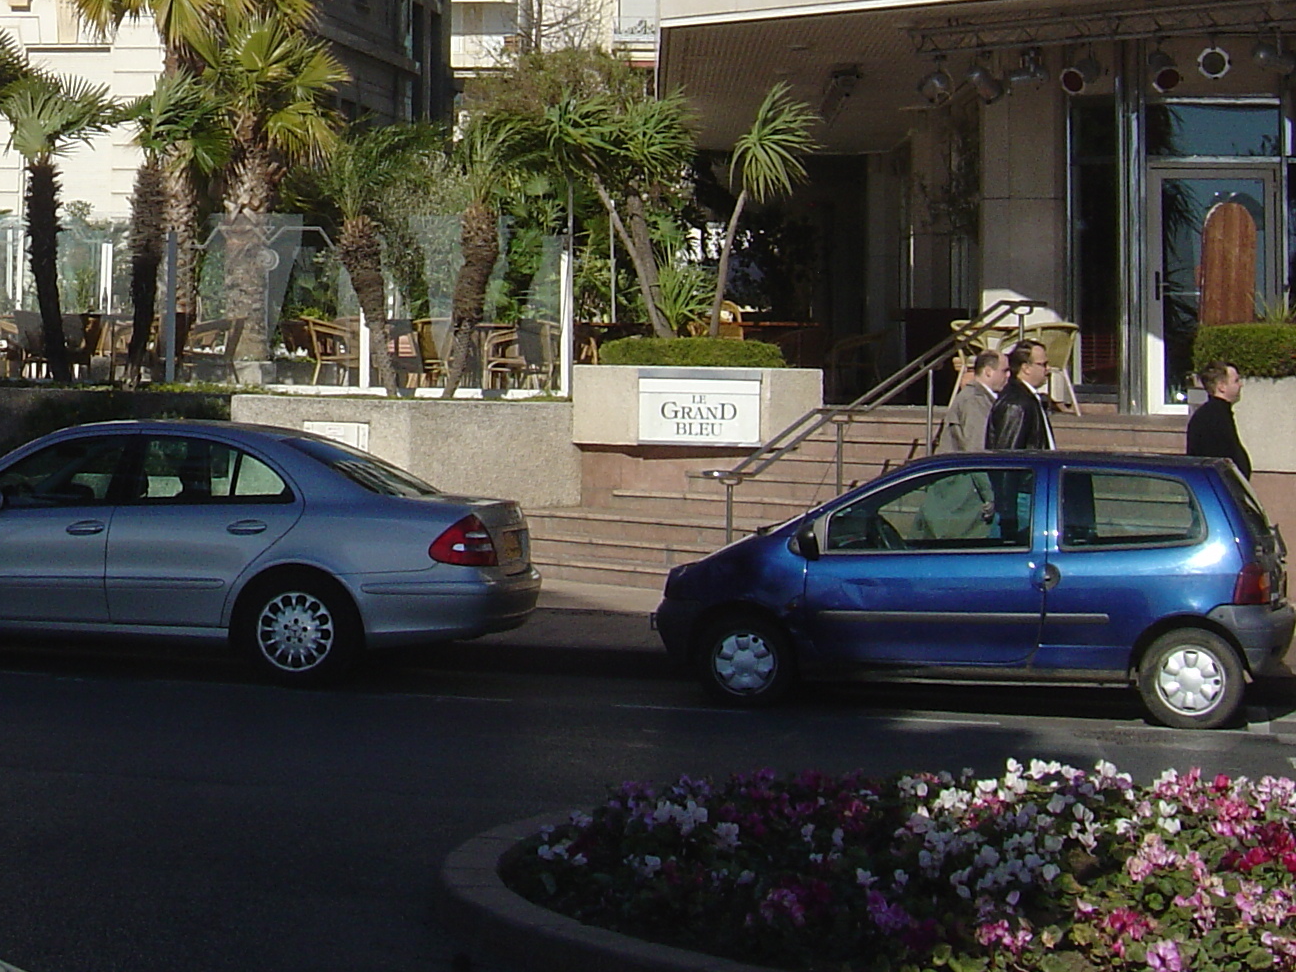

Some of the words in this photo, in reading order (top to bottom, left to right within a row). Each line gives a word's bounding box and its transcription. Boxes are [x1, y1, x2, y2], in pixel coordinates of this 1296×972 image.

[691, 394, 707, 405] LE
[660, 401, 738, 421] GRAND
[674, 422, 723, 437] BLEU
